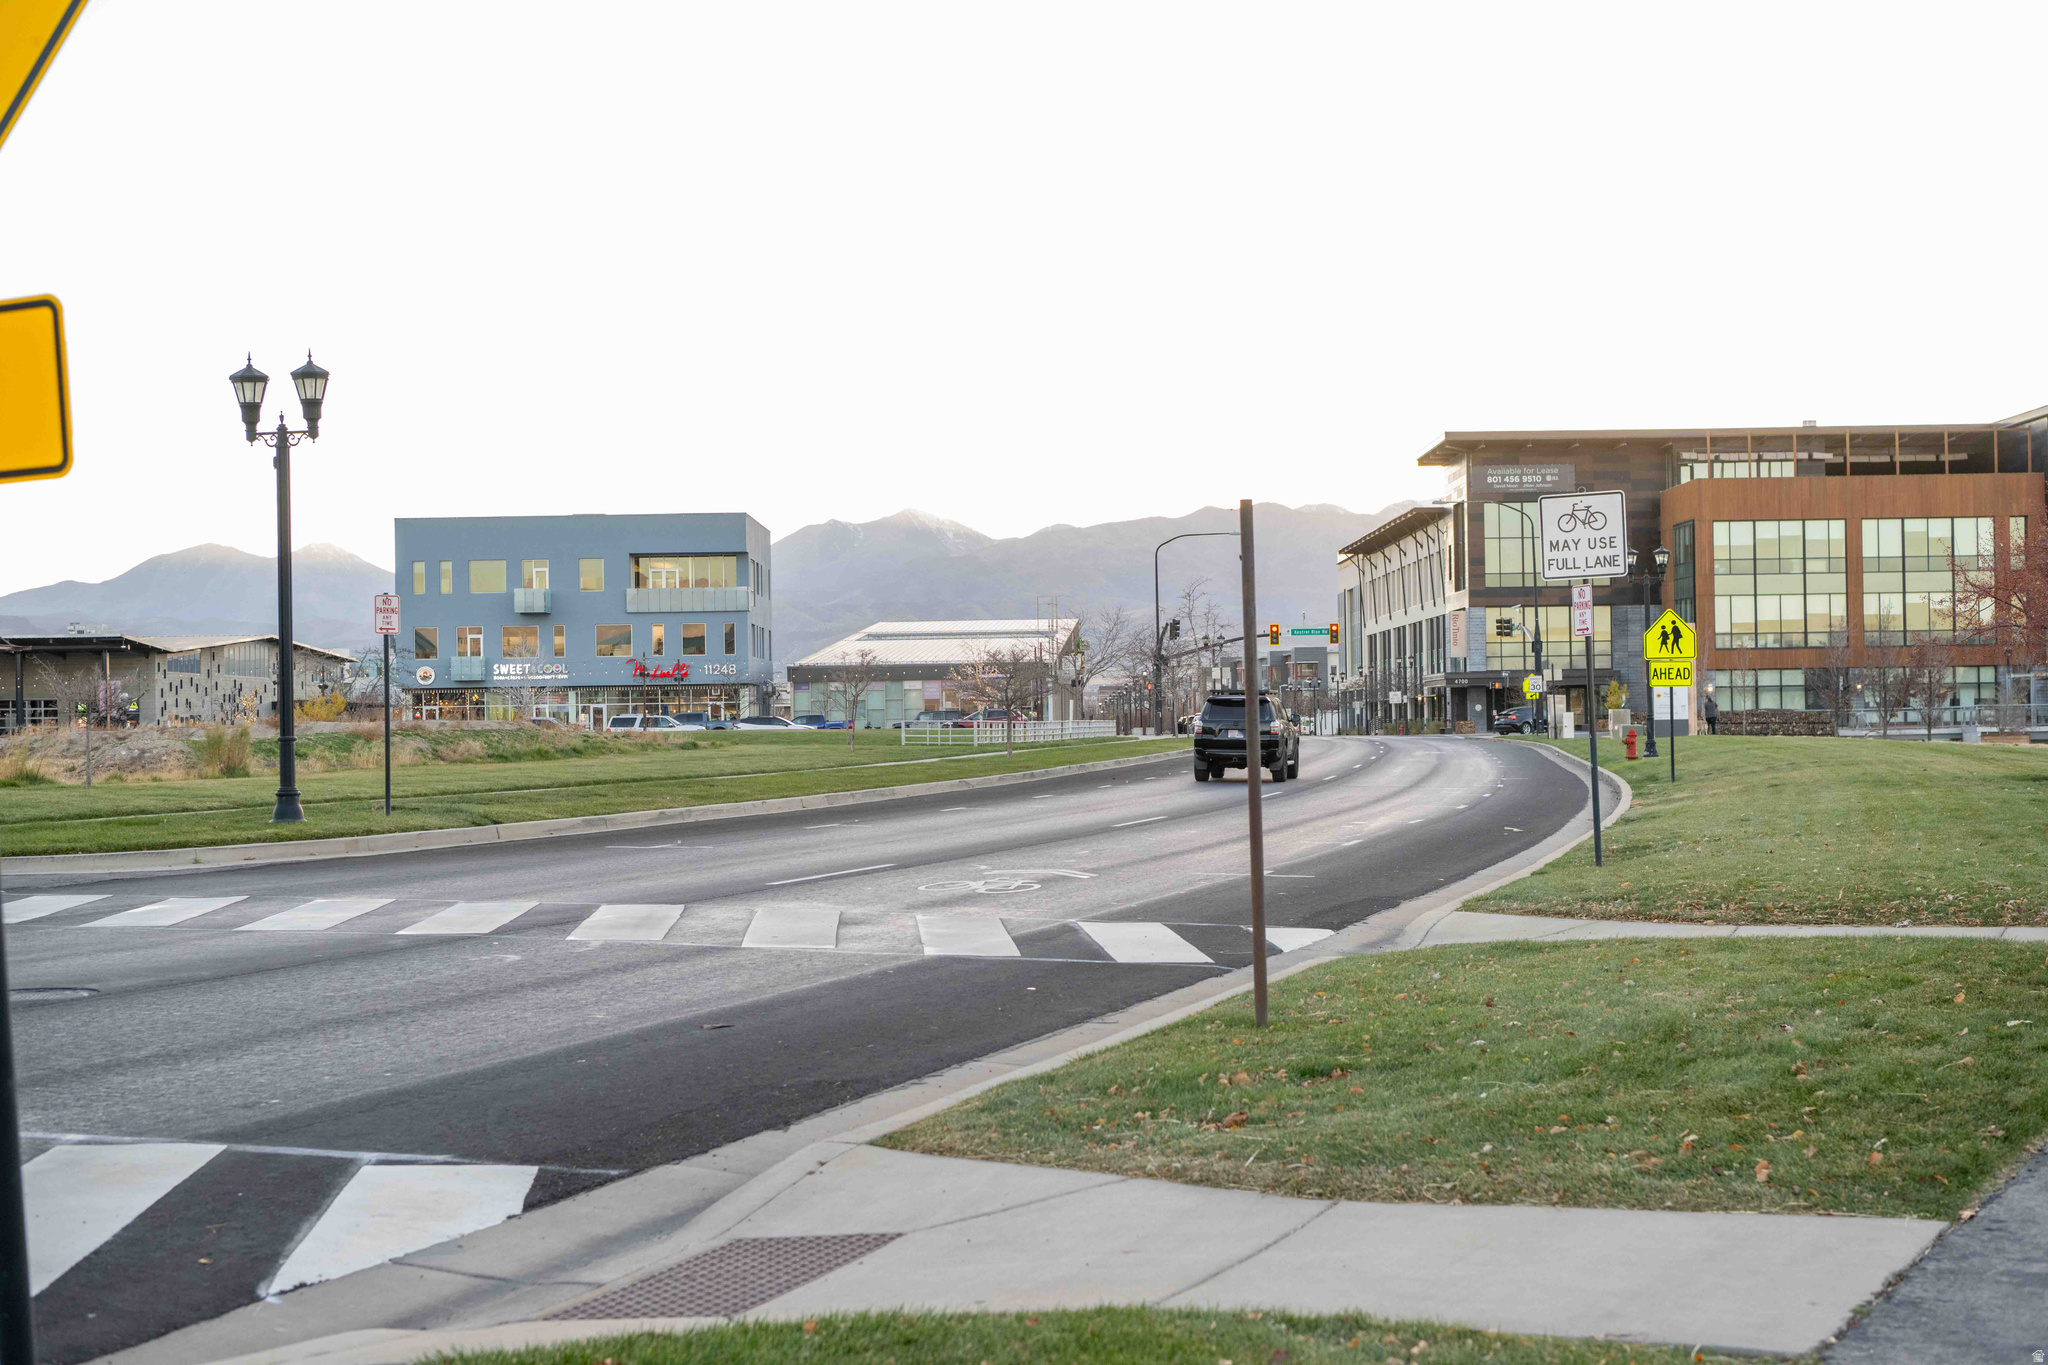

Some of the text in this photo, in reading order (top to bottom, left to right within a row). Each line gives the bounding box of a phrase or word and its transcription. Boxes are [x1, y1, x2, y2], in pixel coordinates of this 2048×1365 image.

[1550, 536, 1617, 552] MAY USE
[1548, 555, 1620, 571] FULL LANE
[1578, 590, 1586, 599] NO
[1574, 600, 1591, 610] PARKING
[493, 664, 530, 674] SWEET
[538, 664, 568, 674] COOL
[704, 664, 736, 675] 11248
[1652, 668, 1690, 680] AHEAD
